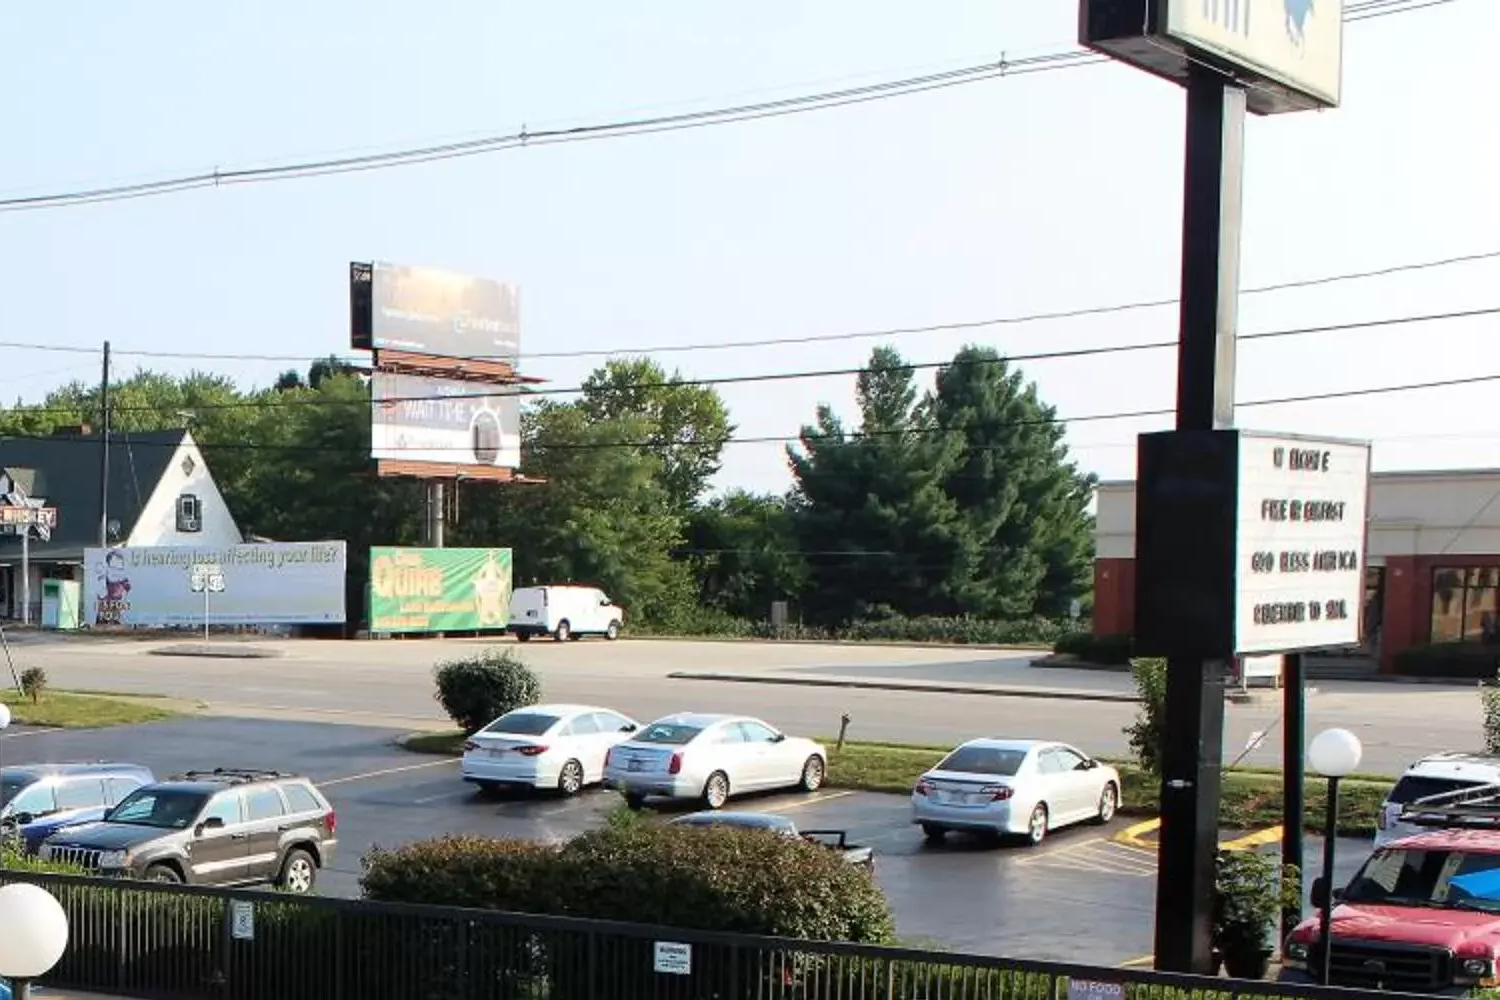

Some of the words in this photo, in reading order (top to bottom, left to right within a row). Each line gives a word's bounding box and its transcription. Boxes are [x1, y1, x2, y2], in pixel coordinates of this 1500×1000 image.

[144, 551, 190, 571] hearing
[193, 550, 219, 565] loss
[221, 548, 275, 569] affecting
[279, 550, 309, 568] your
[312, 546, 337, 564] life?
[1090, 982, 1121, 995] FOOD
